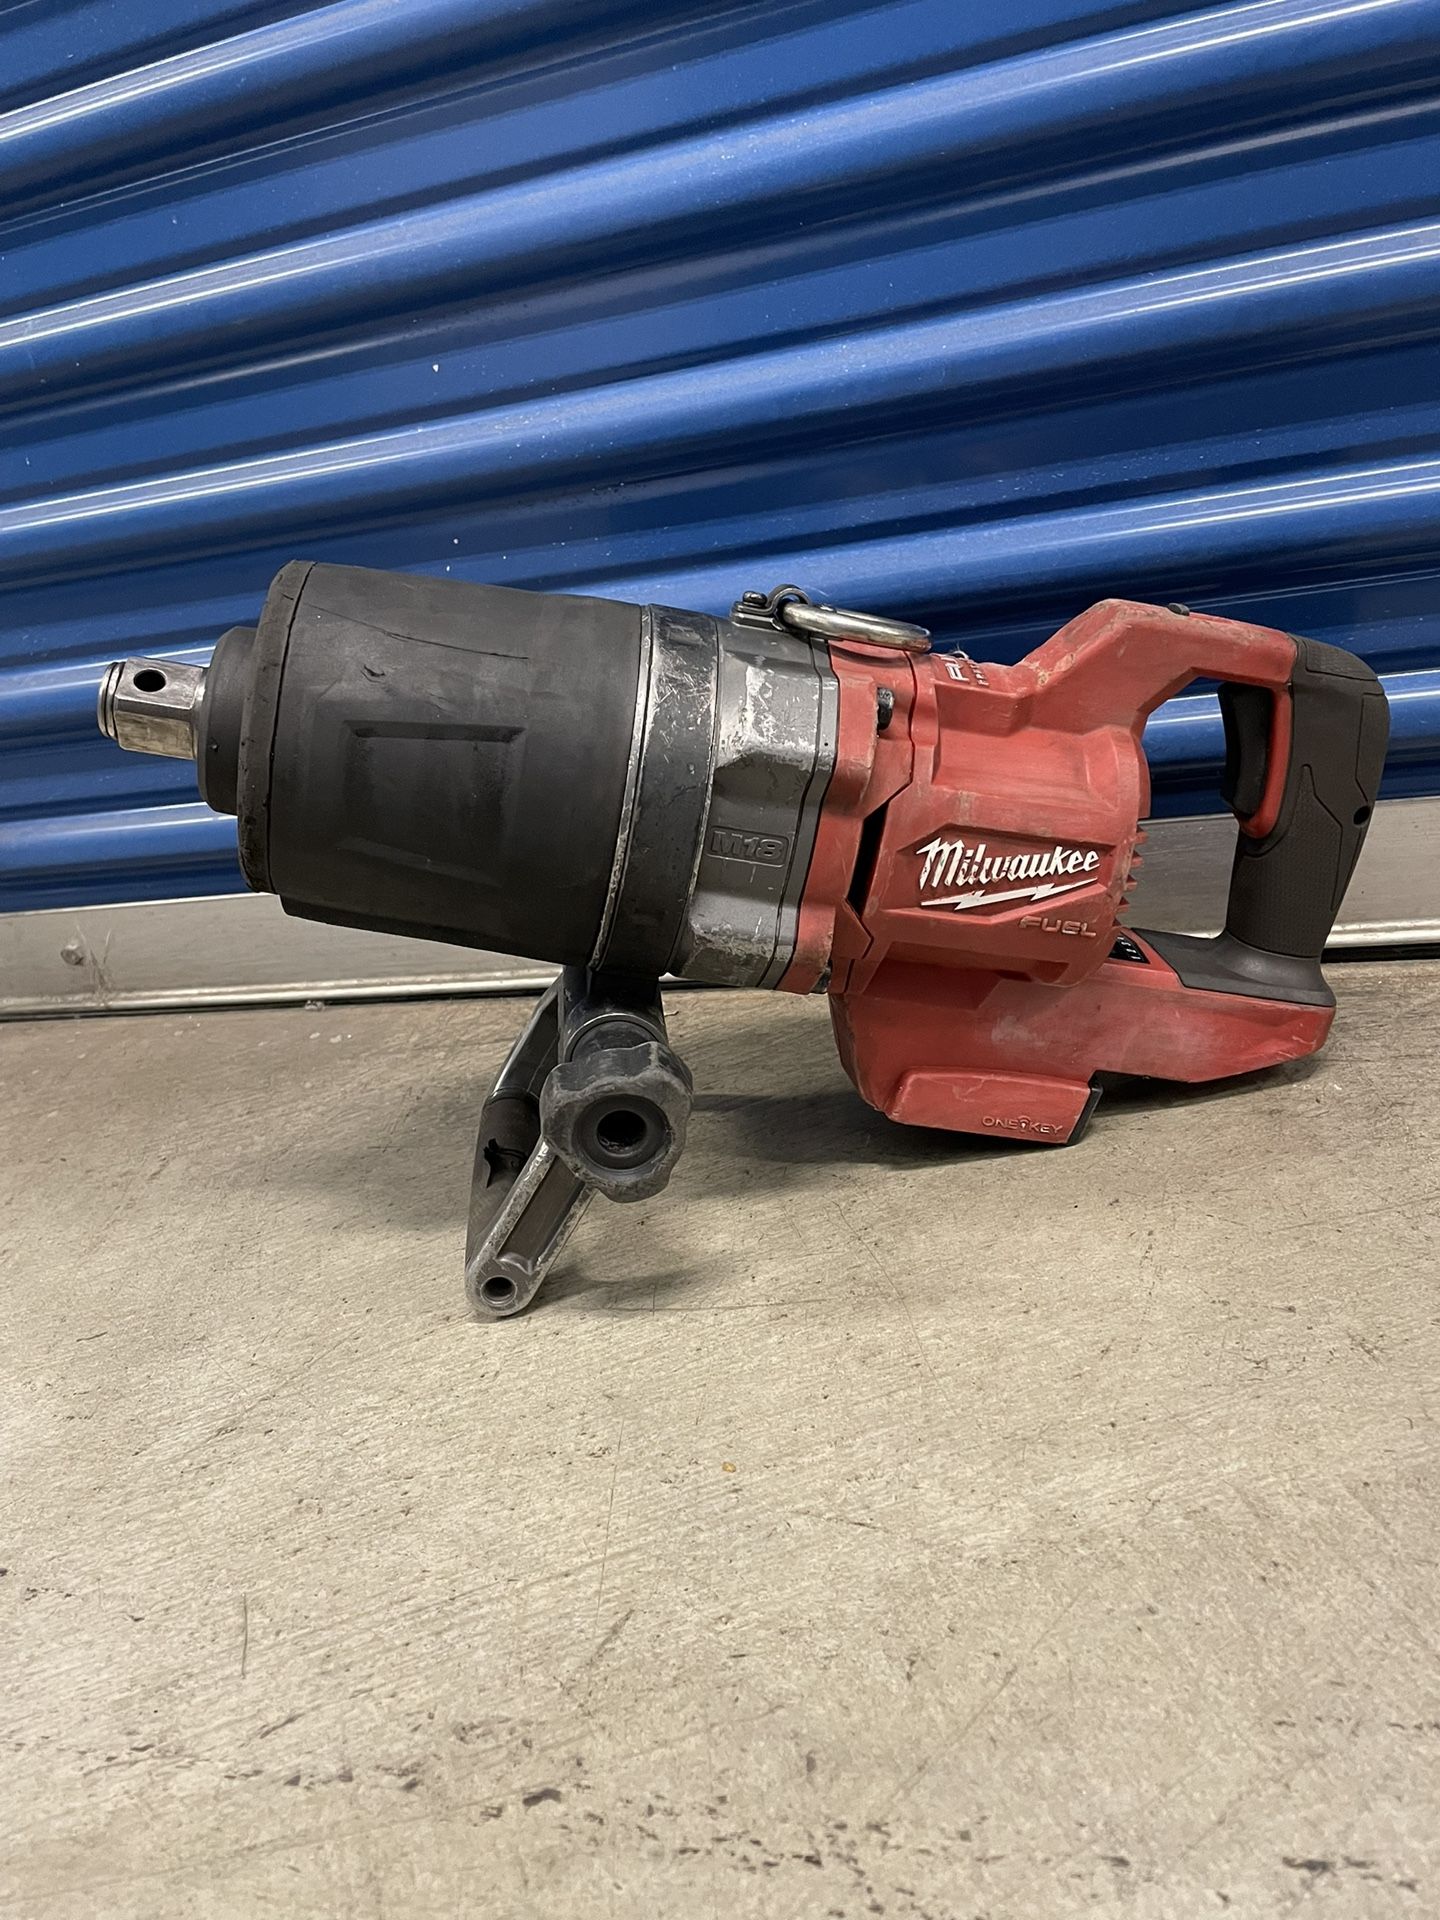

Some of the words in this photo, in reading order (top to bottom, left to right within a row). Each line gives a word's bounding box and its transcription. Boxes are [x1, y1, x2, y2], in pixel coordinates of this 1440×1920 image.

[710, 830, 784, 859] M18
[916, 837, 1100, 890] Milwaukee
[1018, 915, 1097, 938] FUEL
